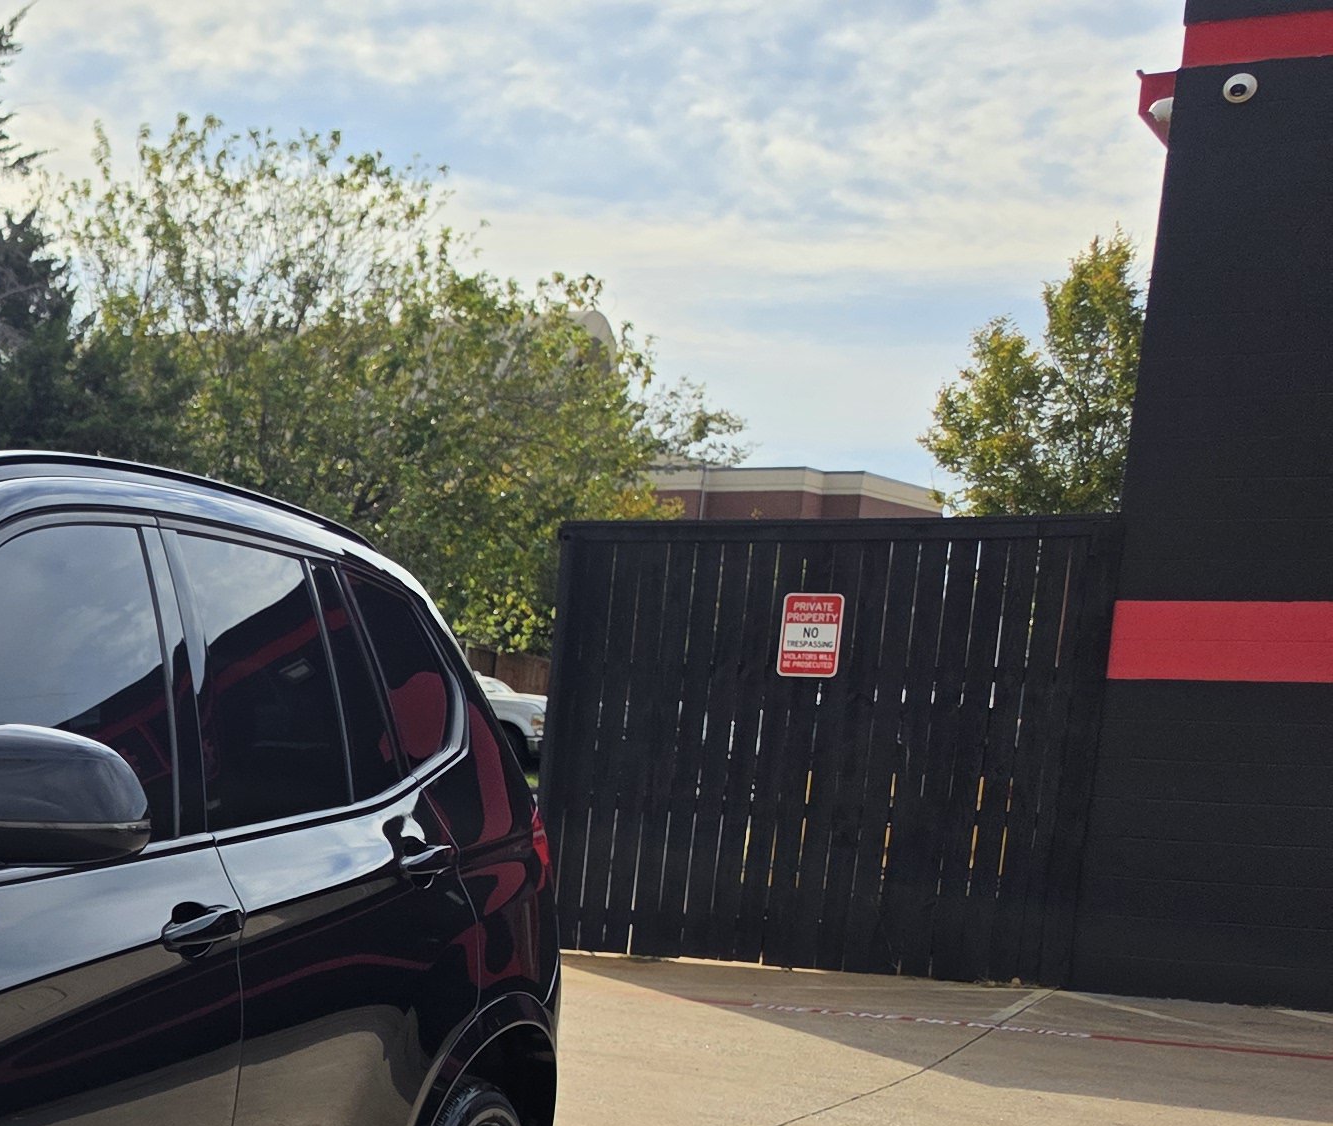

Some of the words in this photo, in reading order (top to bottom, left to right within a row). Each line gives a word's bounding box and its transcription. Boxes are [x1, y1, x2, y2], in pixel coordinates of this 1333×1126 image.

[793, 601, 834, 612] PRIVATE
[786, 612, 838, 622] PROPERTY
[802, 627, 819, 639] NO
[786, 640, 833, 648] TRESPASSING
[782, 653, 818, 661] VIOLATORS
[818, 653, 833, 661] WILL
[782, 660, 791, 668] BE
[791, 661, 833, 669] PROSECUTED
